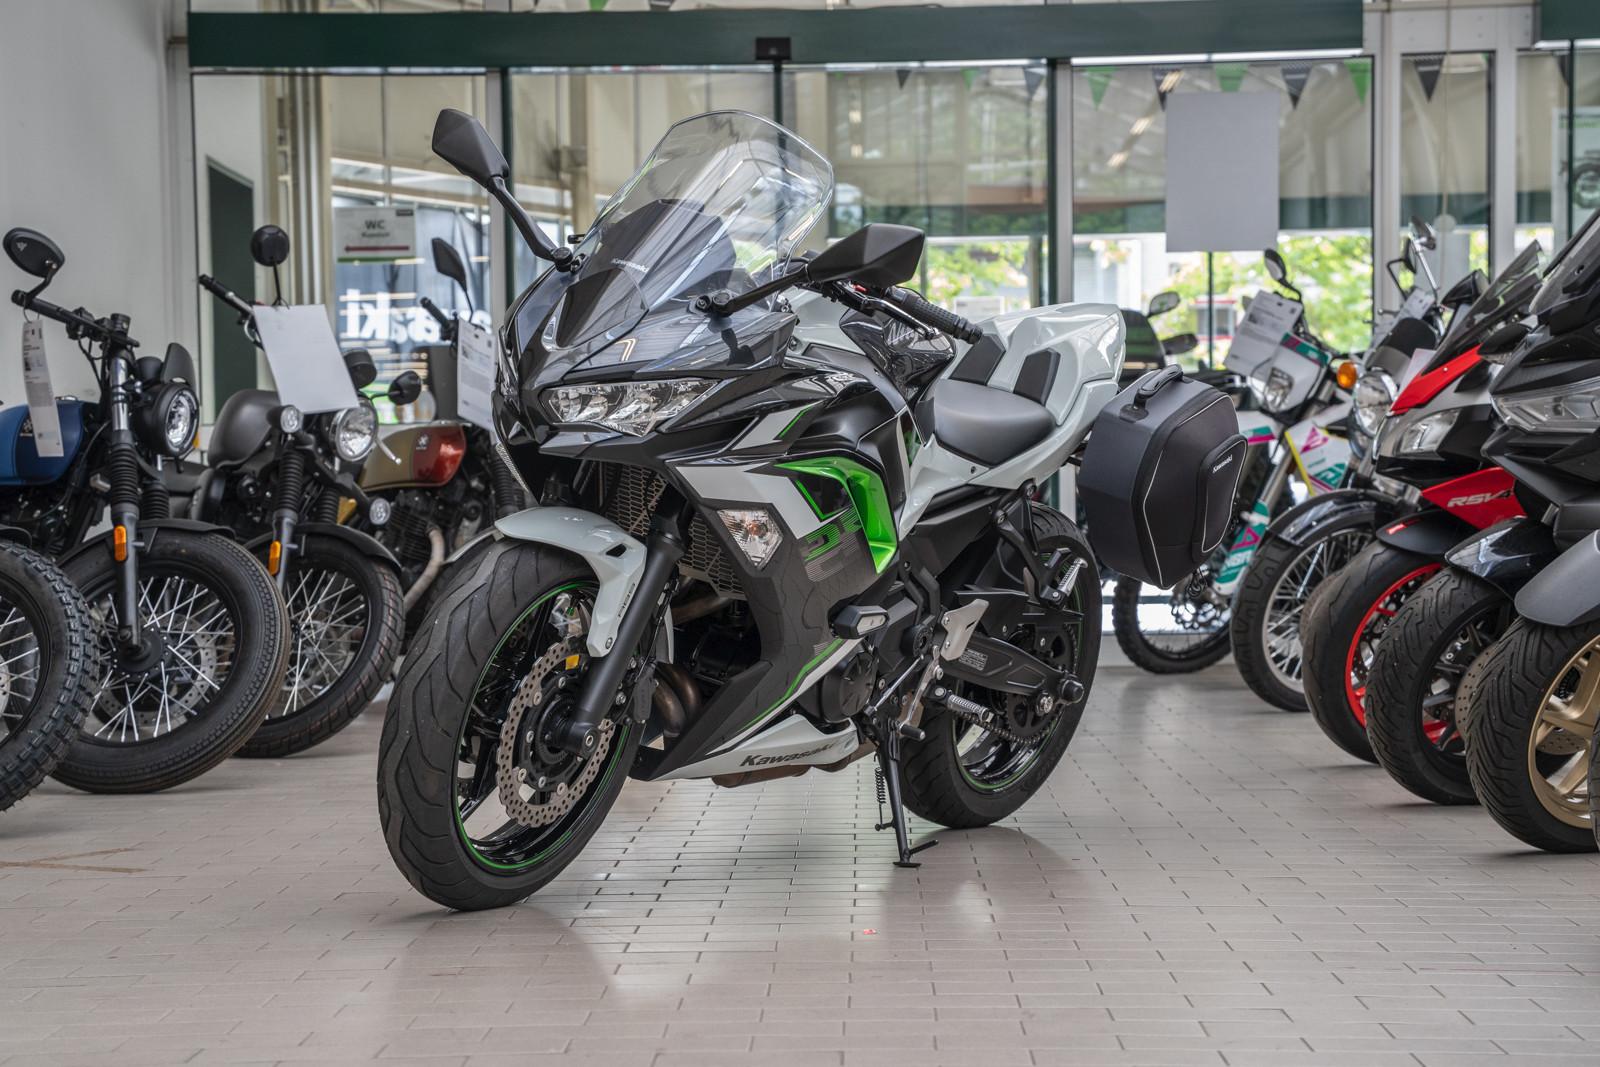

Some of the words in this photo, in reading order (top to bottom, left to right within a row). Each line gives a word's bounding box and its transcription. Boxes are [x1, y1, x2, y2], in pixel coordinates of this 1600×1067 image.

[365, 219, 385, 230] WC
[1447, 487, 1515, 508] RSV4
[740, 744, 833, 767] Kawasaki
